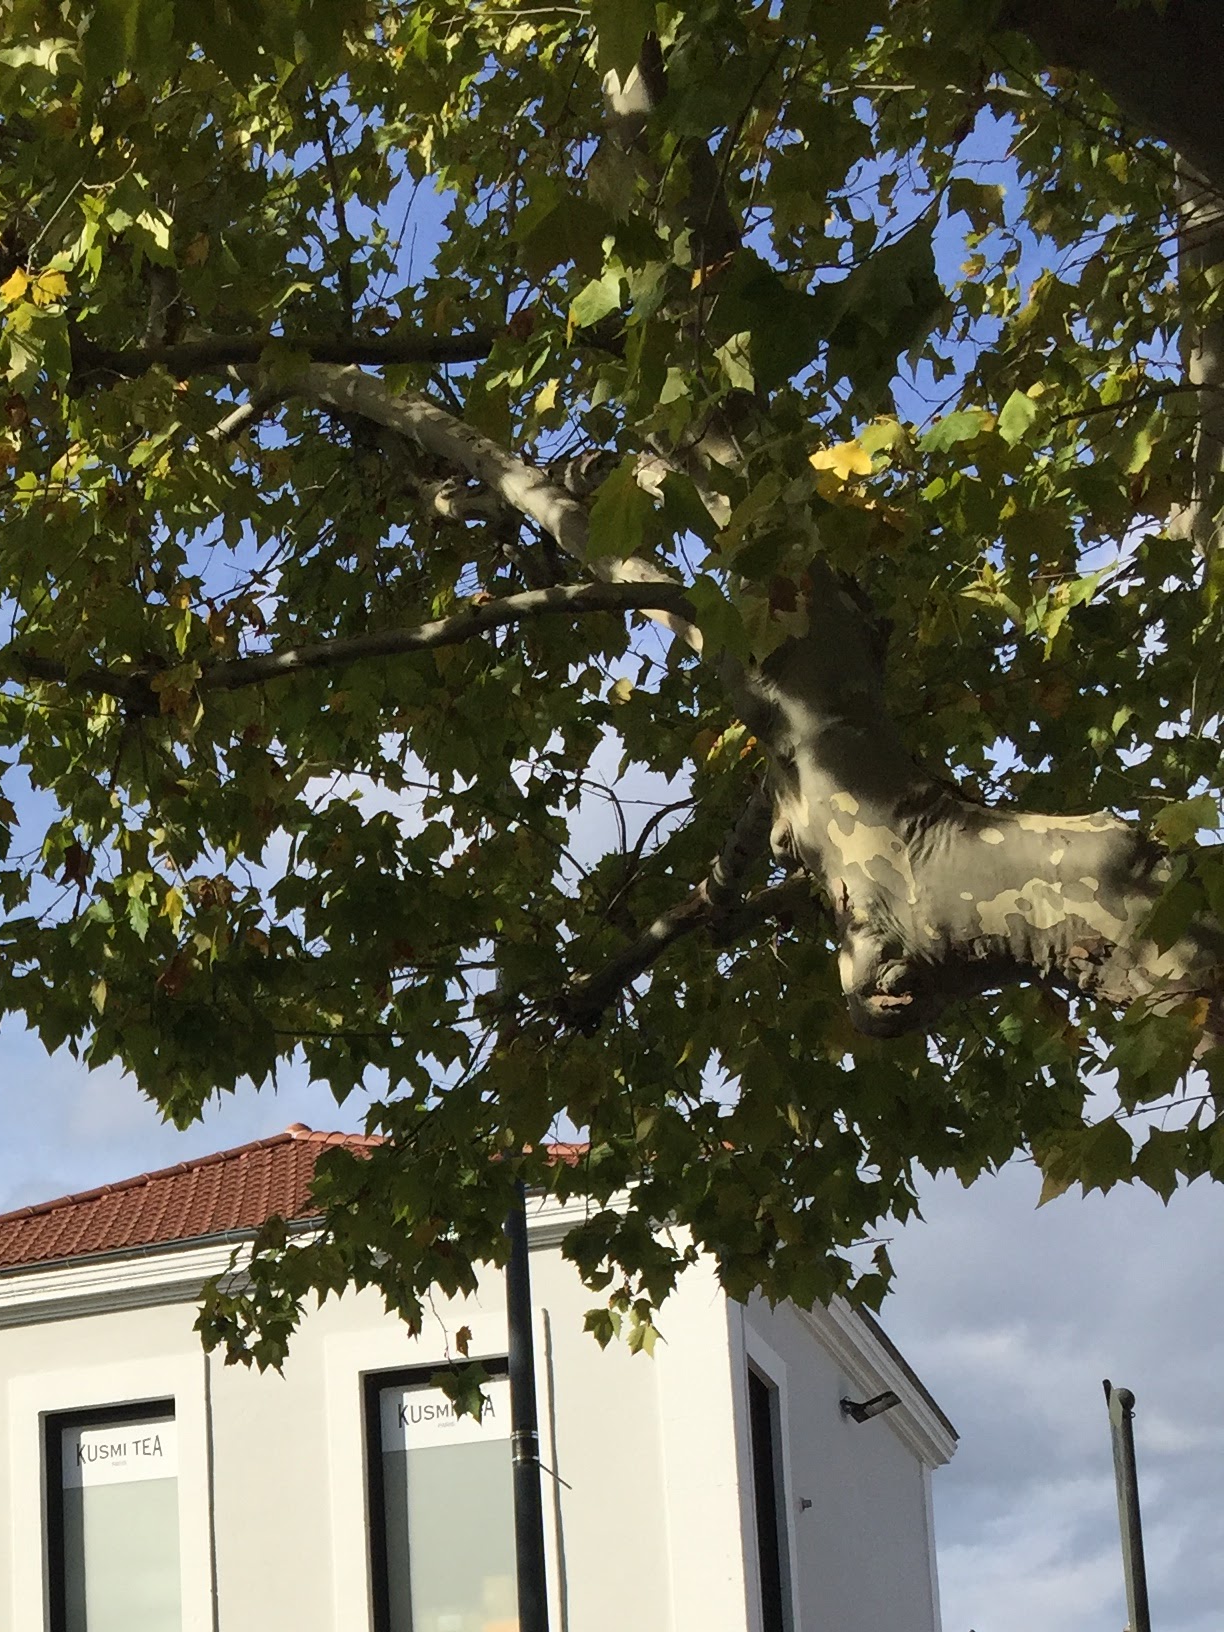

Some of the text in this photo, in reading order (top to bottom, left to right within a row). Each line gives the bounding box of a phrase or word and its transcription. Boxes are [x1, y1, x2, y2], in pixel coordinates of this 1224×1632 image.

[397, 1403, 455, 1429] KUSMI
[76, 1434, 163, 1467] KUSMI TEA
